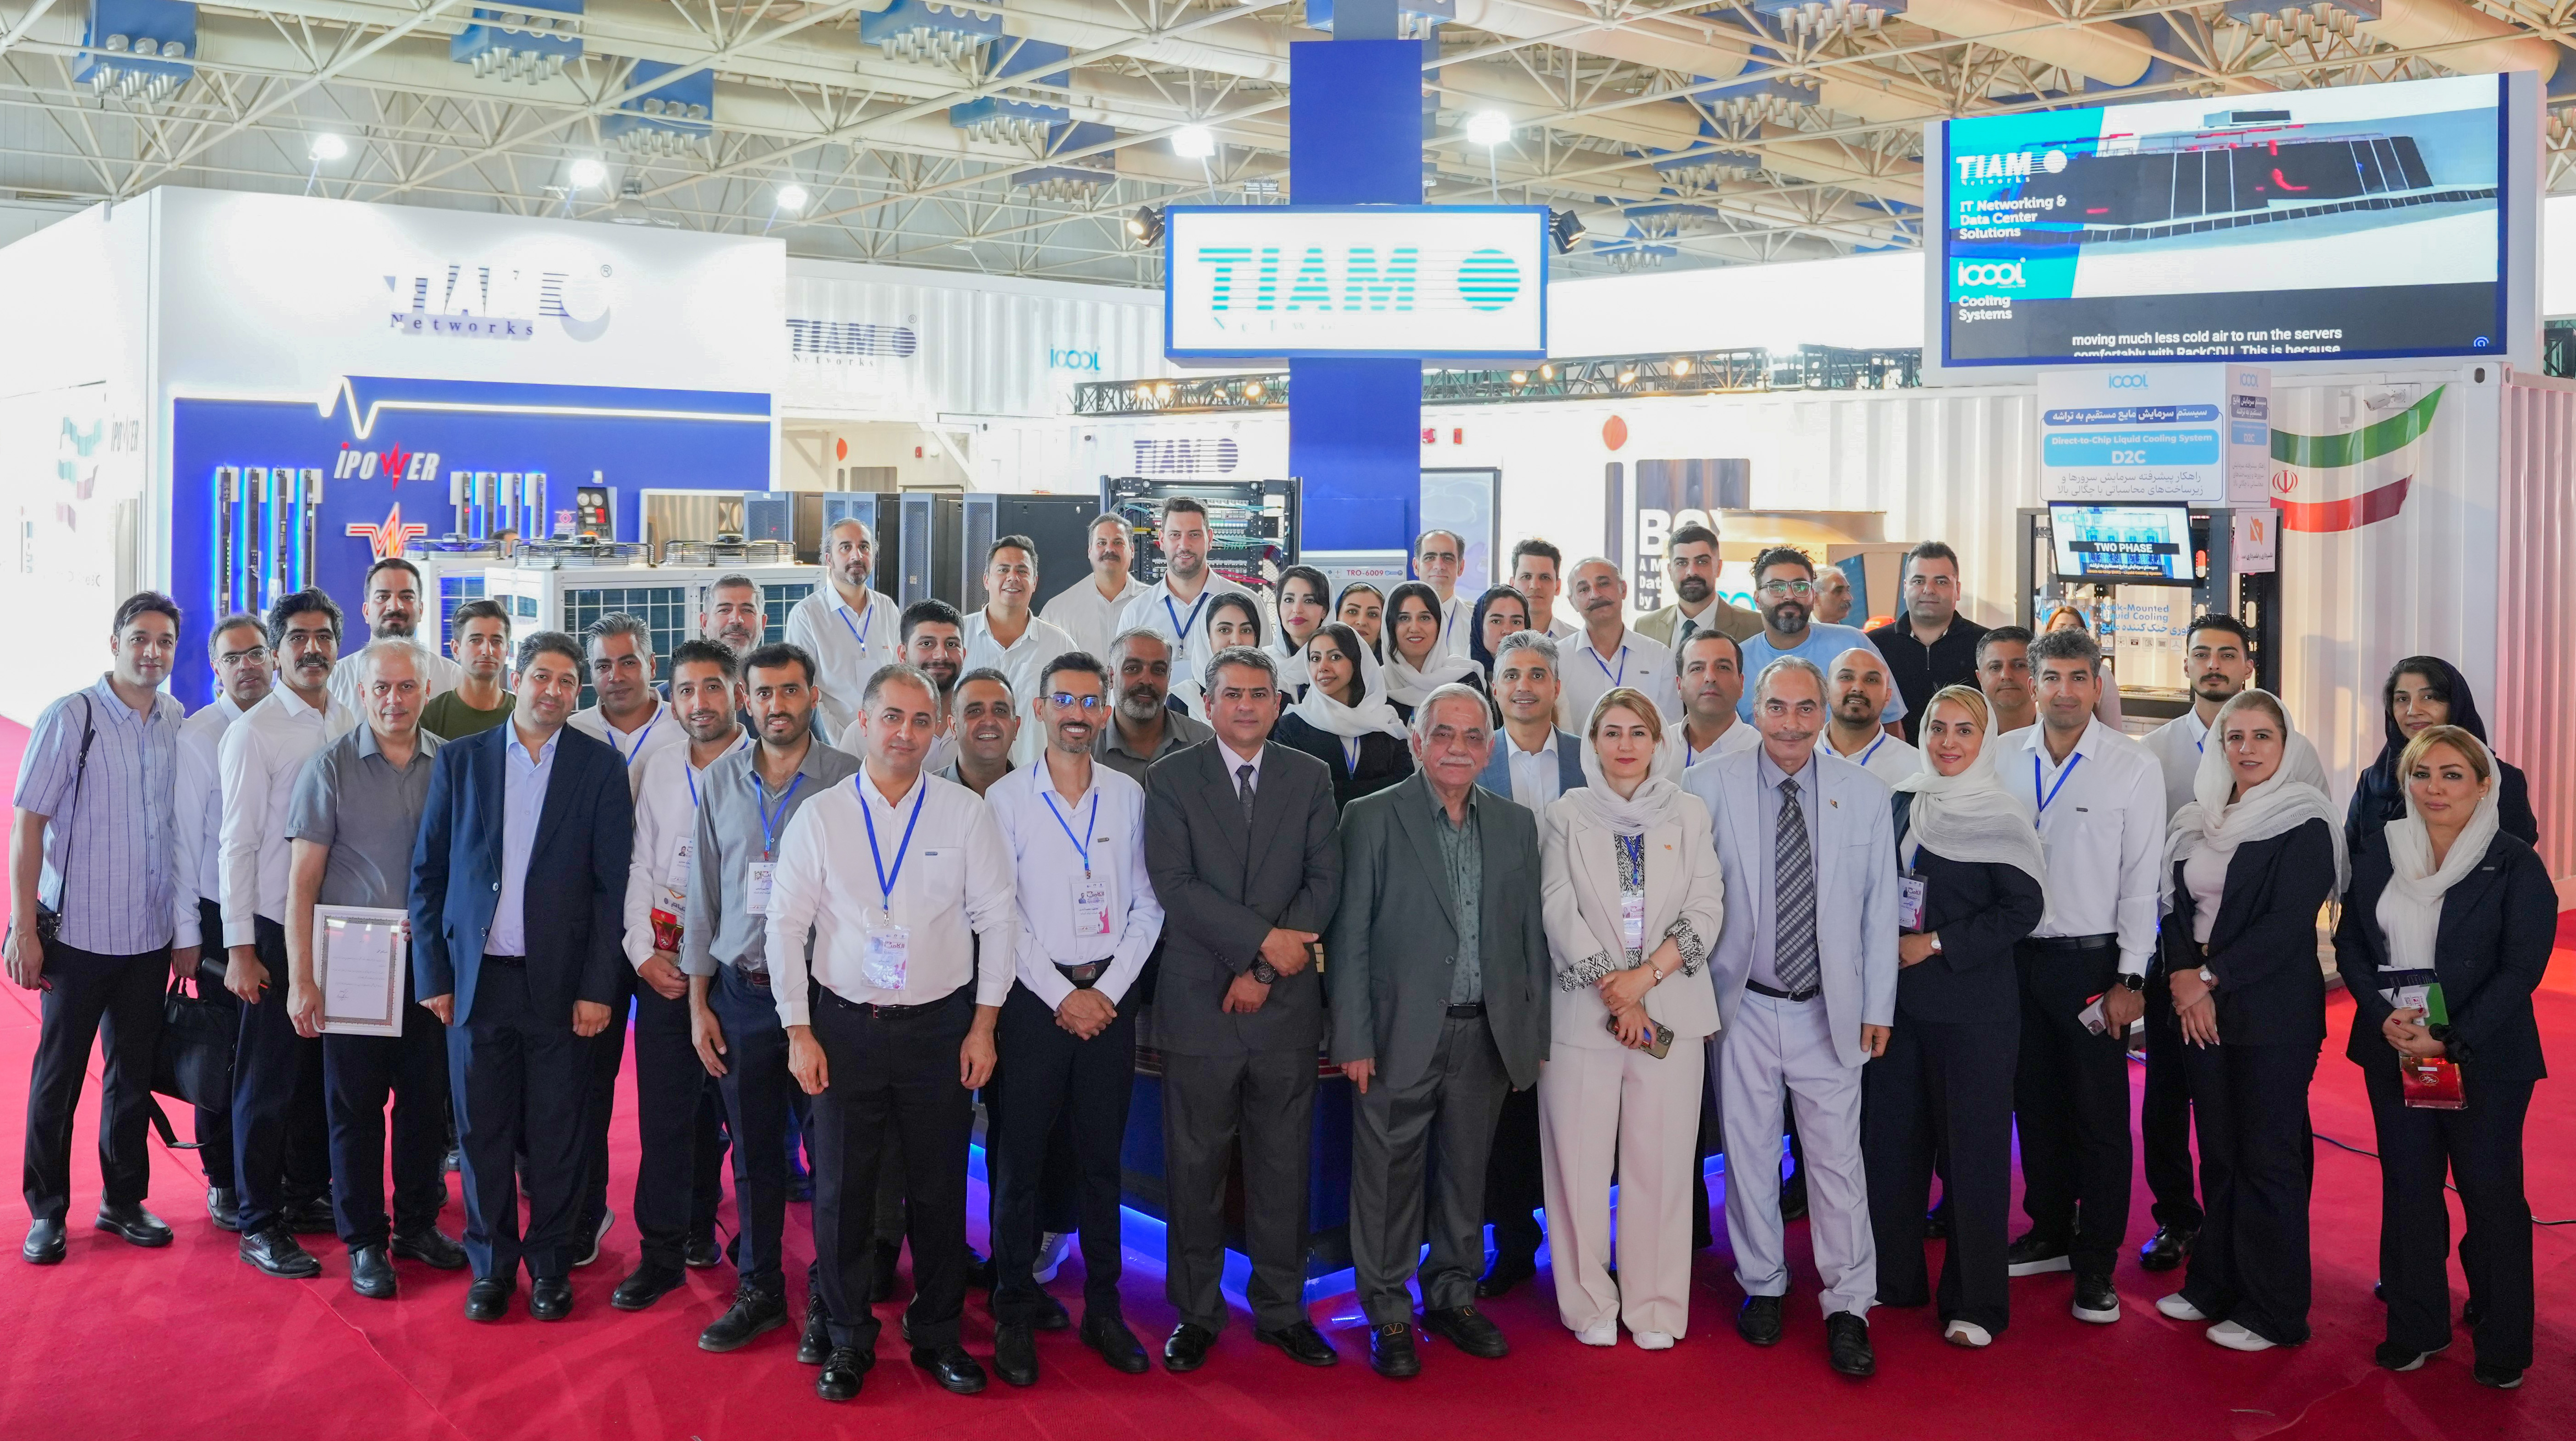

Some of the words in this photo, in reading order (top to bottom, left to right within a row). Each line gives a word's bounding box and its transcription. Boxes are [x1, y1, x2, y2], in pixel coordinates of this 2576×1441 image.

[1960, 200, 1974, 212] IT
[1976, 197, 2054, 211] Networking
[2056, 194, 2066, 207] &
[1960, 215, 1990, 226] Data
[1993, 212, 2038, 224] Center
[1960, 226, 2021, 239] Solutions
[1199, 248, 1419, 310] TIAM
[1959, 295, 2011, 308] Cooling
[1959, 309, 2012, 323] Systems
[391, 314, 534, 336] Networks
[2072, 335, 2116, 347] moving
[2118, 332, 2152, 344] much
[2155, 332, 2180, 343] less
[2183, 331, 2209, 342] cold
[2212, 330, 2228, 342] air
[2230, 331, 2244, 342] to
[2247, 331, 2268, 341] run
[2270, 329, 2291, 340] the
[2295, 328, 2342, 340] servers
[2148, 347, 2174, 356] with
[2240, 345, 2268, 354] This
[2271, 345, 2282, 354] is
[793, 354, 874, 366] Networks
[2053, 411, 2074, 422] تراشه
[2075, 413, 2084, 423] به
[2085, 410, 2116, 423] مستقیم
[2118, 409, 2136, 421] مایع
[2138, 409, 2174, 420] سرمایش
[2176, 409, 2207, 421] سیستم
[2052, 436, 2112, 445] Direct-to-Chip
[2114, 435, 2141, 444] Liquid
[2143, 434, 2177, 443] Cooling
[2179, 434, 2212, 443] System
[2111, 450, 2146, 464] D2C
[2069, 473, 2097, 484] سرورها
[2100, 473, 2136, 483] سرمایش
[2139, 470, 2174, 484] پیشرفته
[2175, 472, 2201, 483] راهکار
[2057, 485, 2069, 495] بالا
[2071, 485, 2095, 497] چگالی
[2097, 486, 2103, 494] با
[2105, 485, 2145, 496] محاسباتی
[2094, 542, 2117, 552] TWO
[2119, 543, 2153, 553] PHASE
[1639, 558, 1647, 572] A
[1639, 592, 1654, 610] by
[2100, 603, 2169, 613] Rack-Mounted
[2100, 612, 2129, 621] Liquid
[2133, 613, 2168, 623] Cooling
[2122, 623, 2146, 632] کننده
[2147, 623, 2168, 632] خنک
